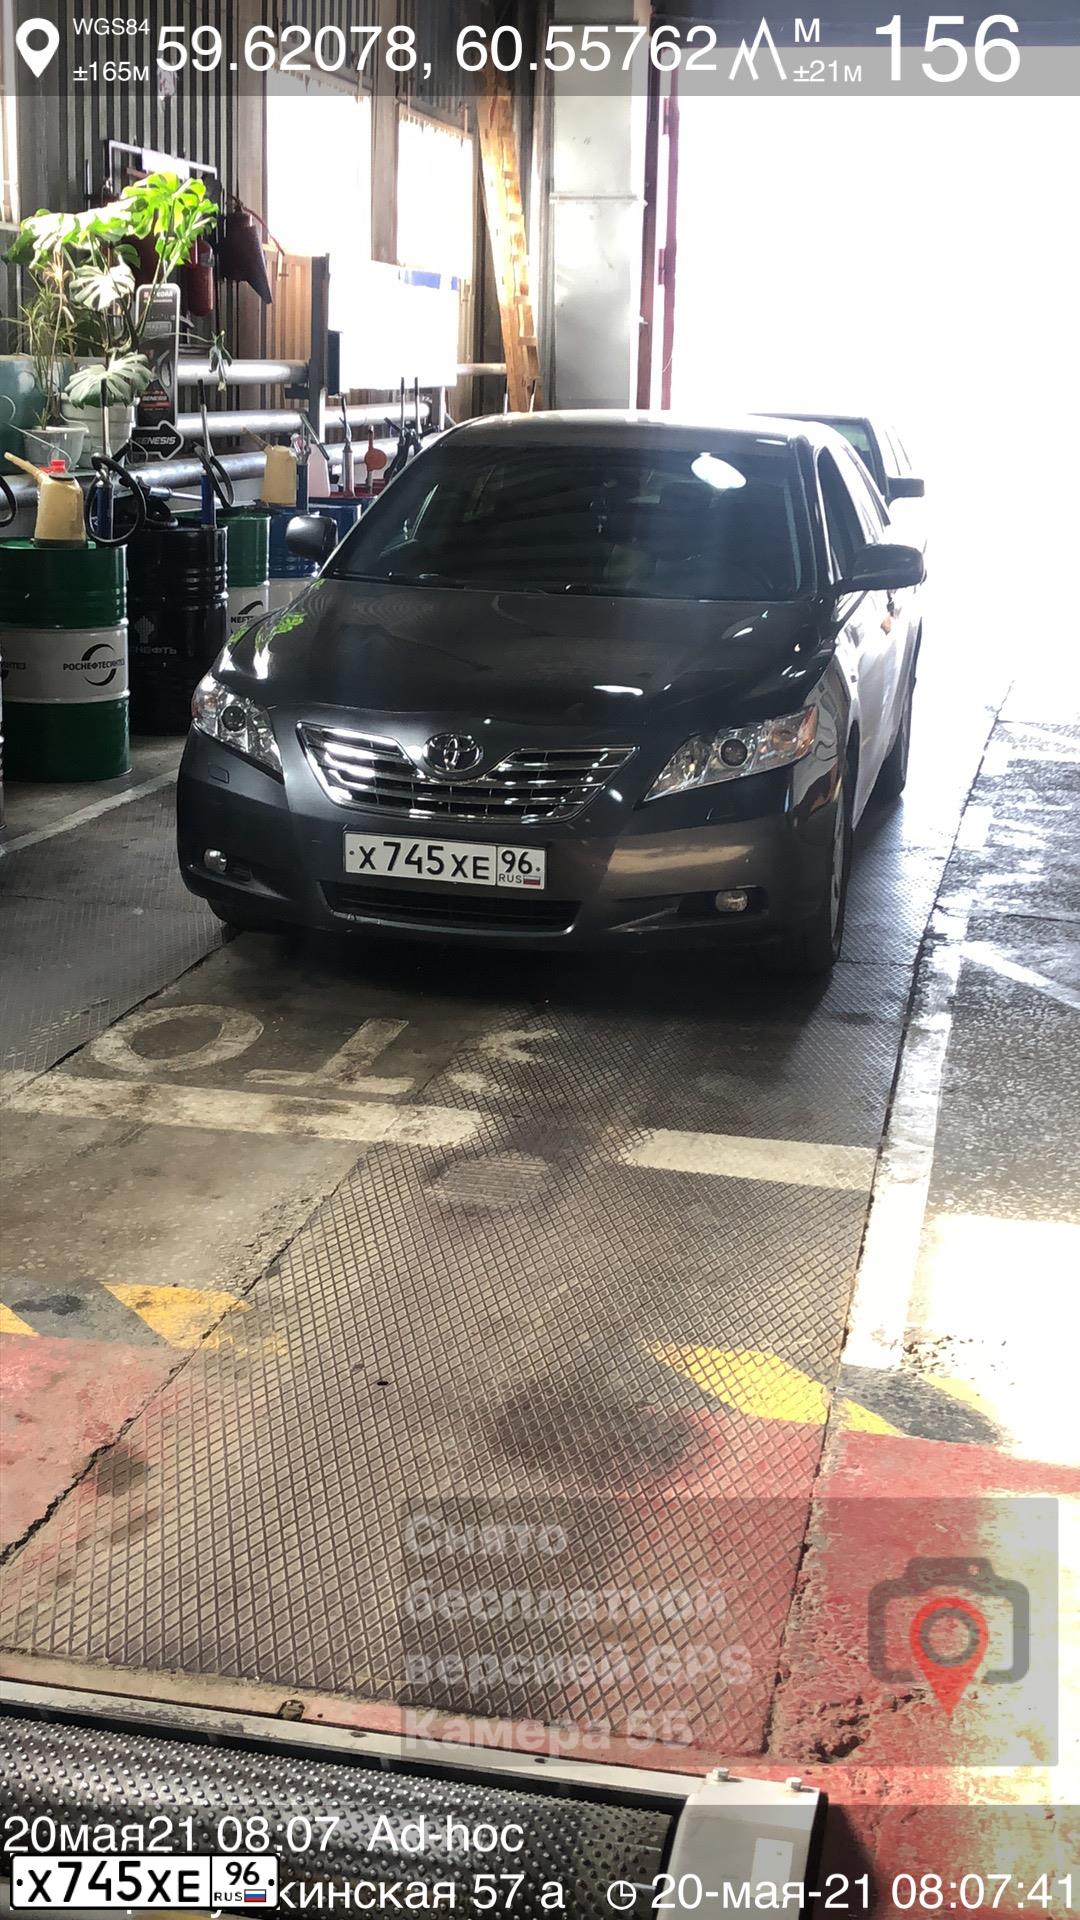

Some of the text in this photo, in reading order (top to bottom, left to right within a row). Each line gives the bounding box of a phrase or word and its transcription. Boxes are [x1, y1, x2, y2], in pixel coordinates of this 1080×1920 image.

[136, 436, 176, 445] GENESIS
[501, 850, 533, 874] 96
[499, 873, 522, 884] RUS
